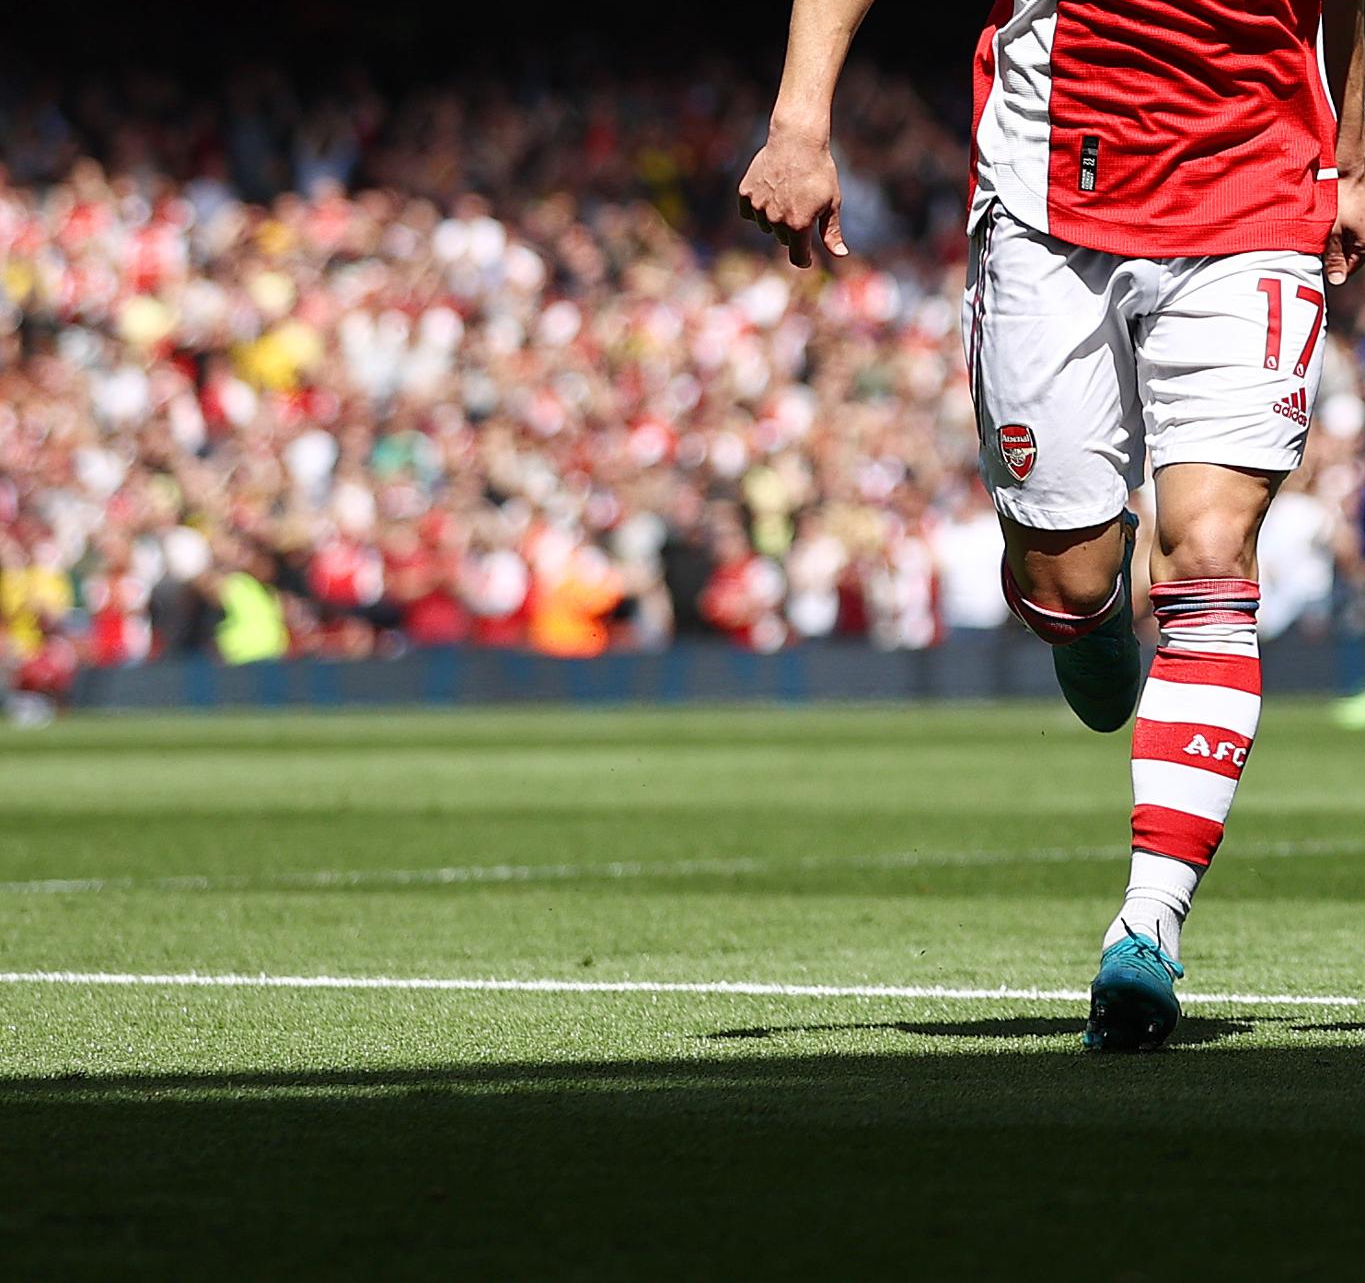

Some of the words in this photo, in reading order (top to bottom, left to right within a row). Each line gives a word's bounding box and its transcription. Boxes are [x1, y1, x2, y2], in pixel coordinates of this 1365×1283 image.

[1256, 277, 1324, 379] 17
[1272, 400, 1309, 427] adidas
[1183, 733, 1247, 768] AFC
